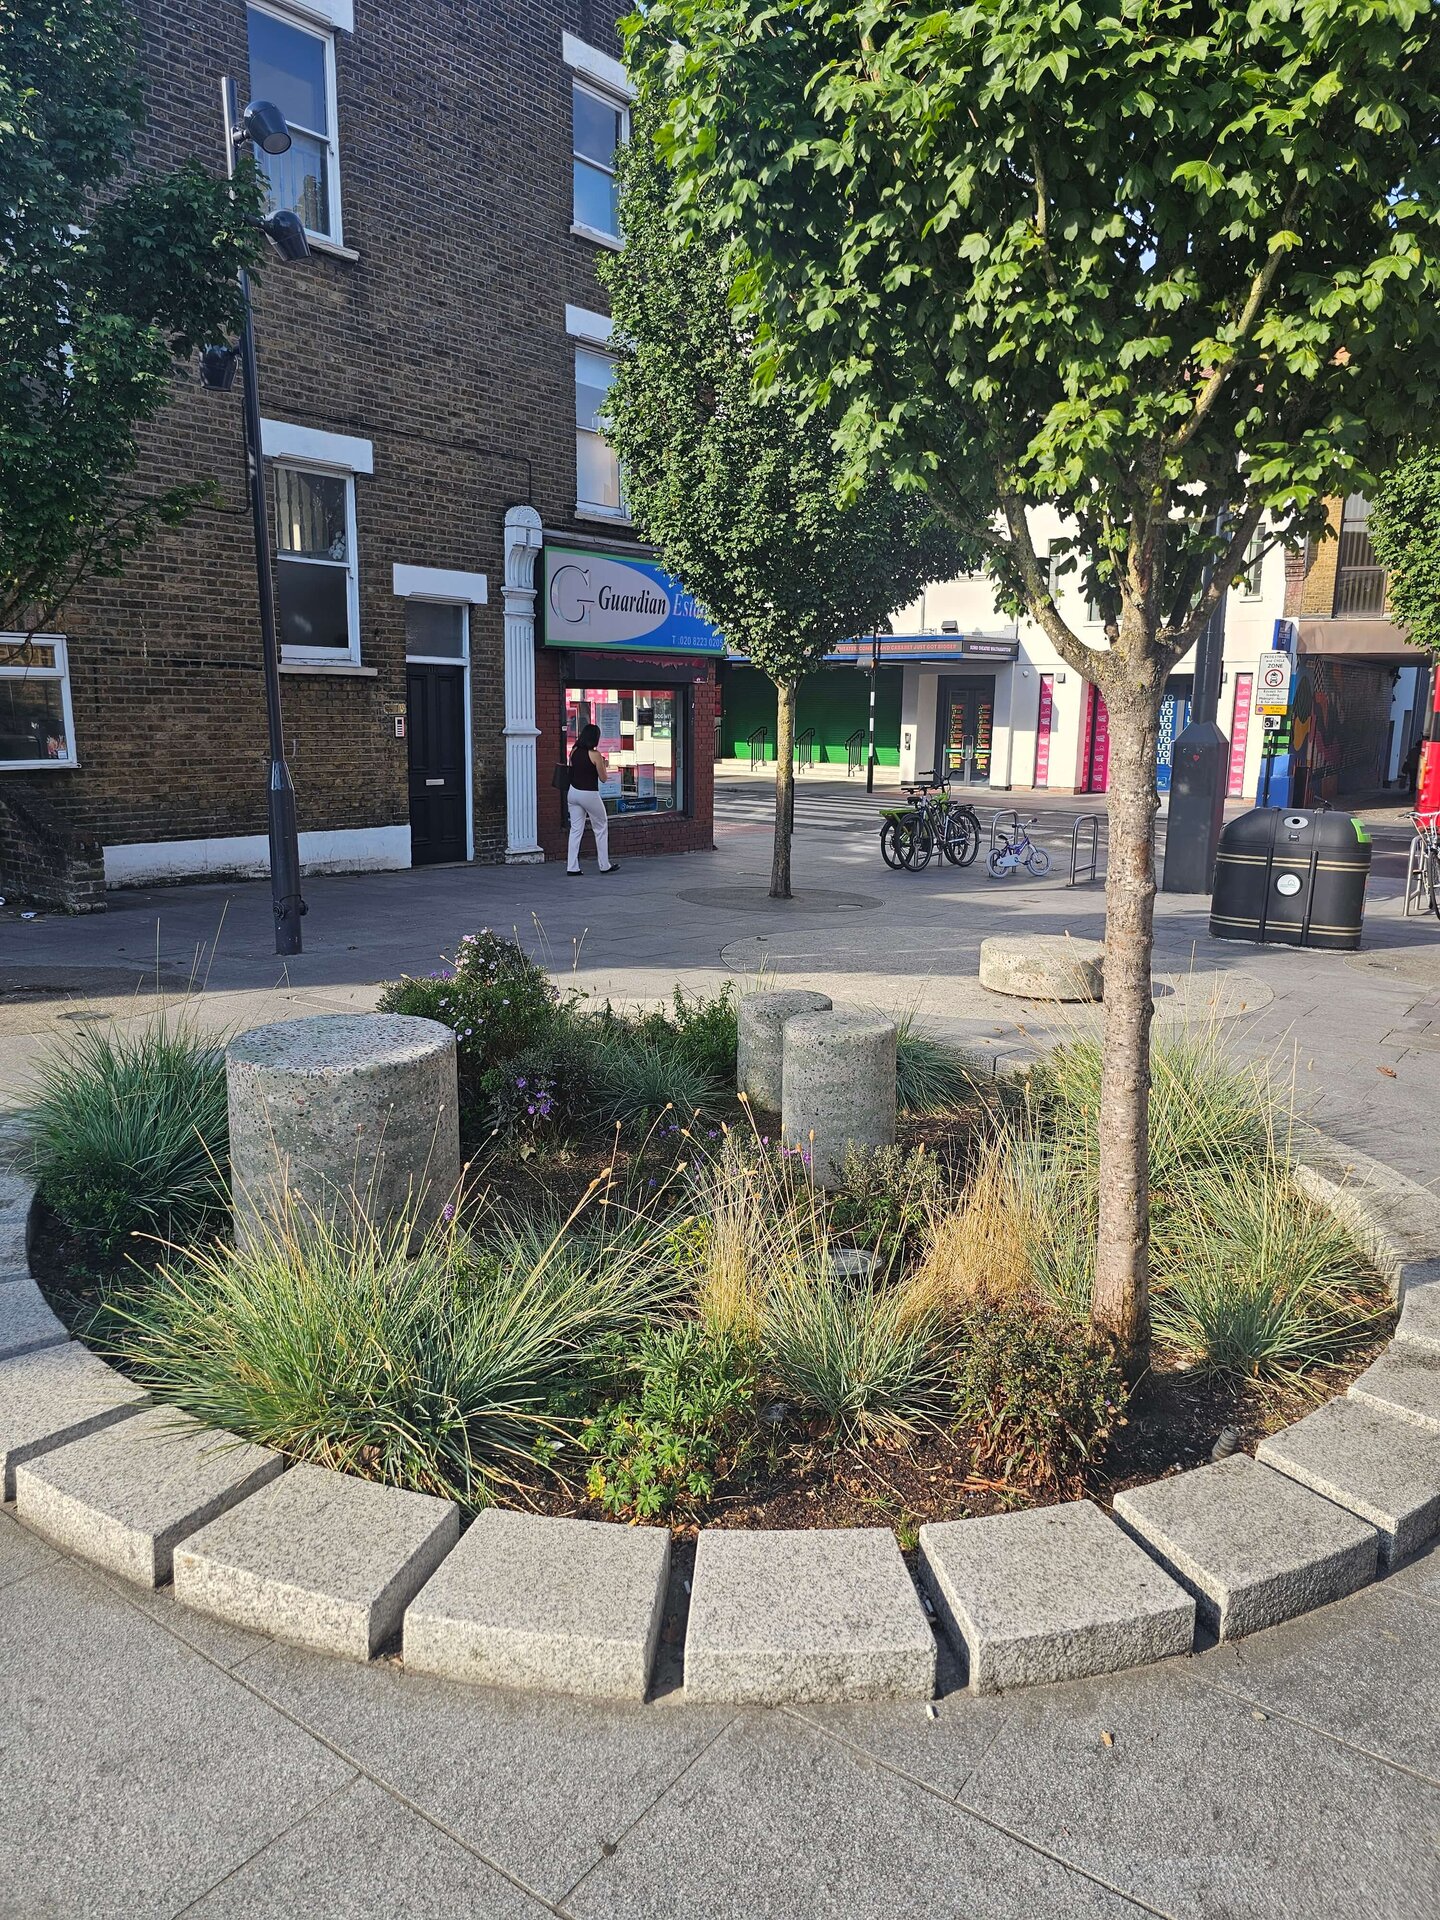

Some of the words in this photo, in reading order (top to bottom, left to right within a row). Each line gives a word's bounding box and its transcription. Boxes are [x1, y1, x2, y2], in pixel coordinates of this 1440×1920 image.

[599, 585, 666, 615] Guardian
[693, 637, 708, 647] 8223
[1160, 722, 1172, 730] TO
[1158, 729, 1172, 737] LET
[1158, 750, 1169, 758] TO
[1156, 757, 1169, 765] LET
